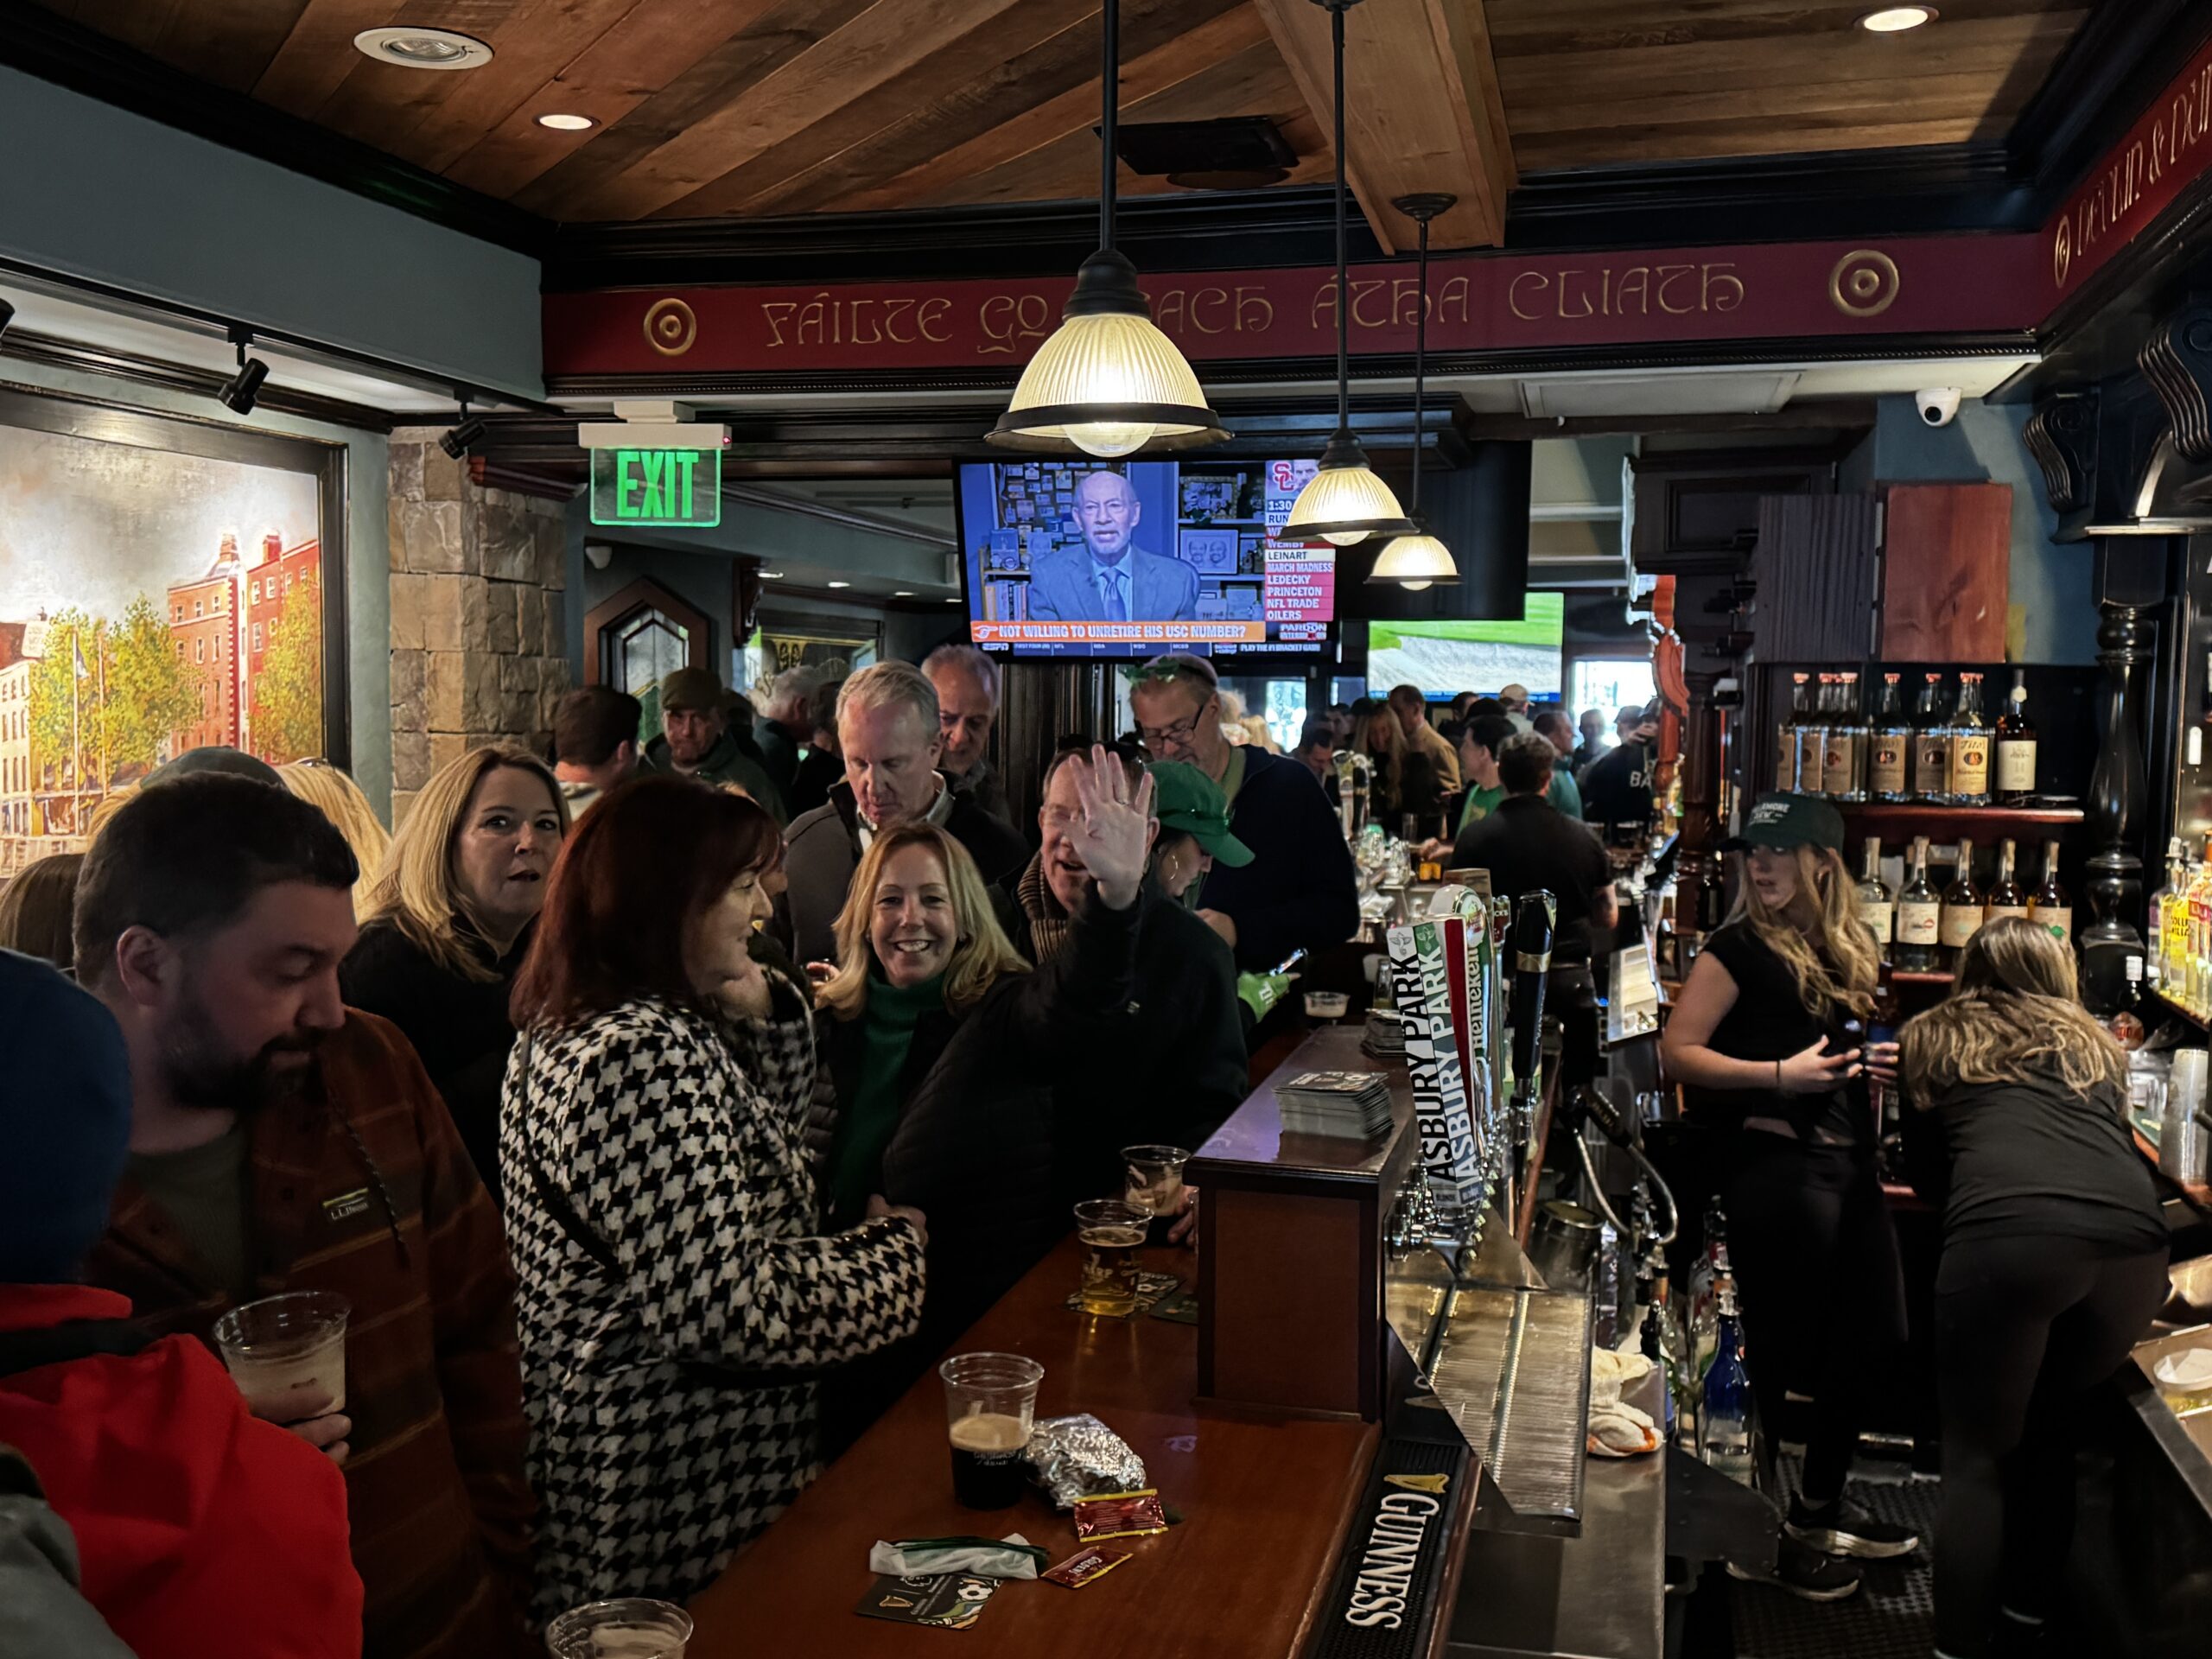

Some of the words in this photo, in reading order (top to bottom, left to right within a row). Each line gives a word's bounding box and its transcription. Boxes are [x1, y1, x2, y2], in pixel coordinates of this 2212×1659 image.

[1509, 264, 1745, 321] CLIATH
[617, 451, 699, 518] EXIT
[1268, 500, 1293, 511] 1:30
[1268, 551, 1307, 560] LEINART
[1268, 563, 1294, 573] MARCH
[1296, 563, 1333, 573] MADNESS
[1268, 575, 1312, 585] LEDECKY
[1268, 586, 1323, 597] PRINCETON
[1267, 598, 1286, 609] NFL
[1287, 598, 1320, 609] TRADE
[1267, 610, 1302, 620] OILERS
[999, 625, 1020, 638] NOT
[1023, 625, 1069, 638] WILLING
[1071, 625, 1085, 638] TO
[1088, 625, 1141, 638] UNRETIRE
[1144, 625, 1165, 638] HIS
[1166, 625, 1189, 638] USC
[1191, 625, 1246, 638] NUMBER?
[1391, 954, 1433, 1044] PARK
[1418, 944, 1456, 1041] PARK
[1466, 945, 1484, 1048] Heineken
[1407, 1056, 1458, 1181] ASBURY
[1435, 1046, 1478, 1184] ASBURY
[1344, 1492, 1440, 1630] GUINNESS
